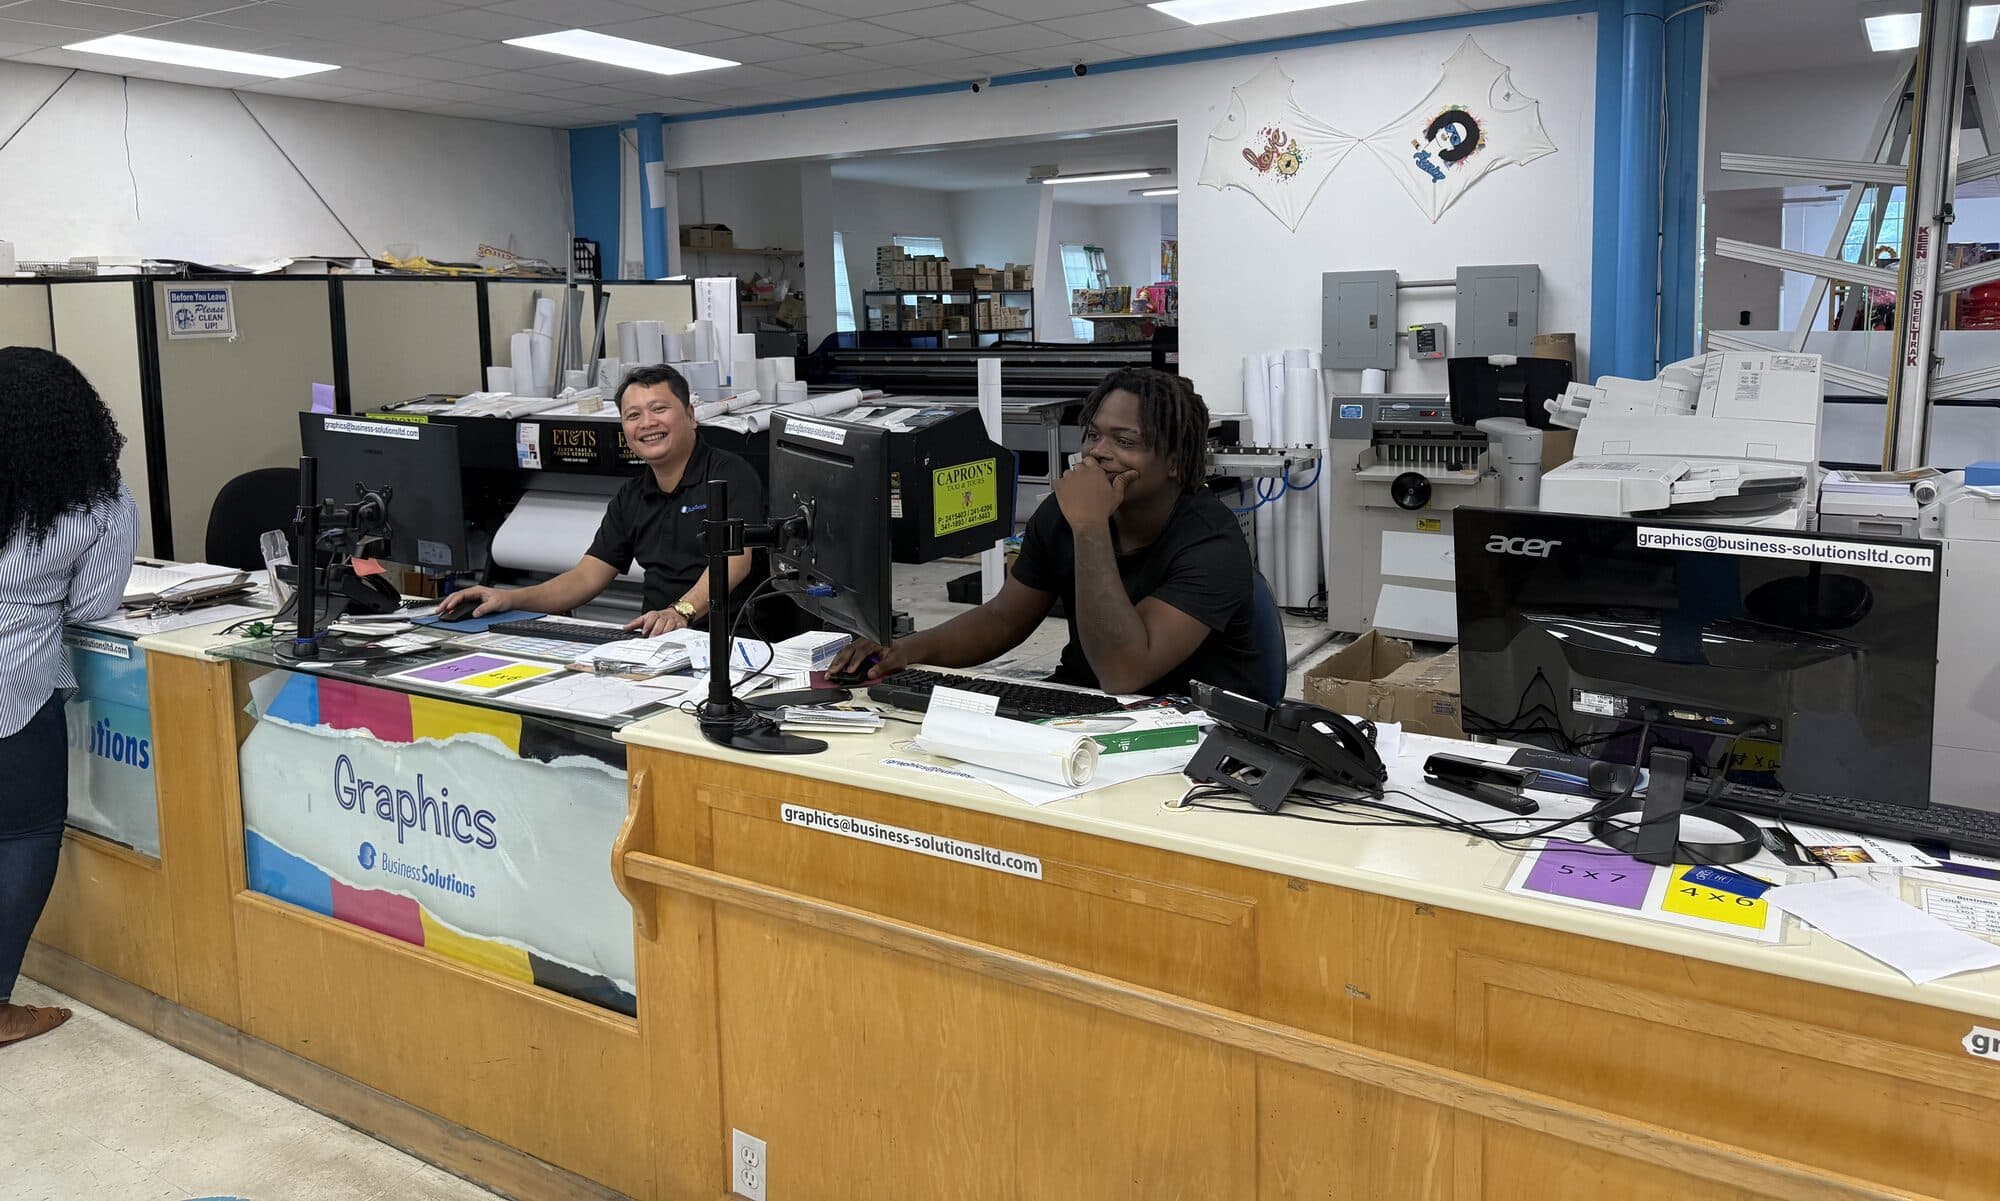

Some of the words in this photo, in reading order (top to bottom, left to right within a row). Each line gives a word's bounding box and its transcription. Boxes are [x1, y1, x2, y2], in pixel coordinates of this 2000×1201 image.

[171, 292, 194, 302] Before
[194, 292, 207, 301] You
[207, 292, 226, 301] Leave
[195, 303, 225, 314] Please
[552, 429, 597, 447] ET&TS
[937, 462, 993, 486] CAPRON'S
[947, 483, 959, 491] TAXI
[1485, 534, 1562, 558] acer
[1638, 531, 1932, 567] graphics@business-solutionsltd.com
[334, 753, 497, 850] Graphics
[784, 806, 1039, 874] graphics@business-solutionsltd.com
[1557, 864, 1576, 875] 5
[1584, 870, 1600, 880] x
[1610, 873, 1628, 883] 7
[1680, 887, 1699, 897] 4
[1709, 893, 1726, 903] x
[1735, 896, 1755, 907] 6
